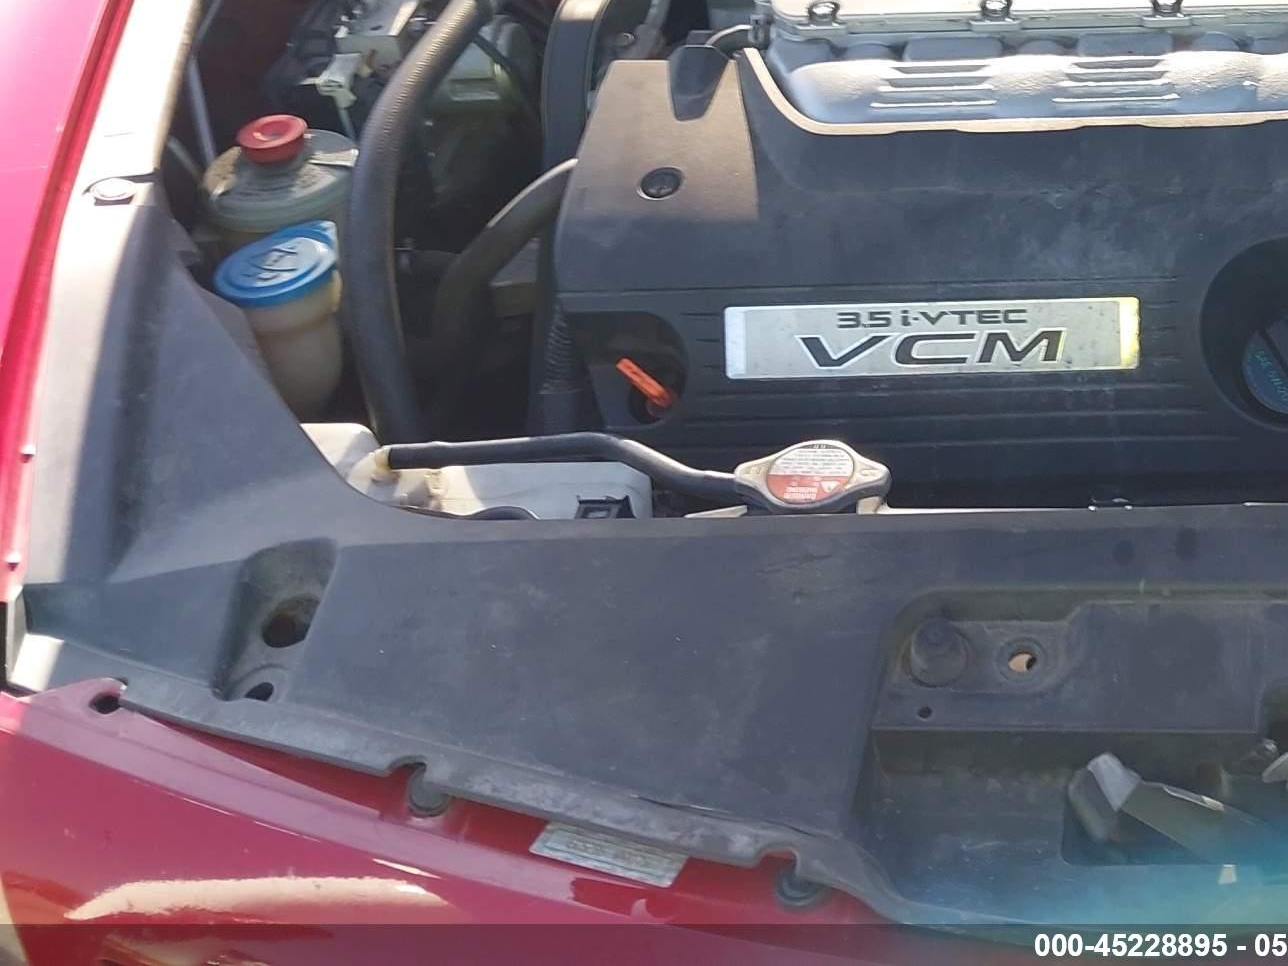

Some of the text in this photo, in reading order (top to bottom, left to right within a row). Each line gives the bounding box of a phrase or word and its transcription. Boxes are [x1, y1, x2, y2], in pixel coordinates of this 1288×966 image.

[837, 309, 1027, 328] 3.5 i-VTEC
[798, 329, 1064, 368] VCM
